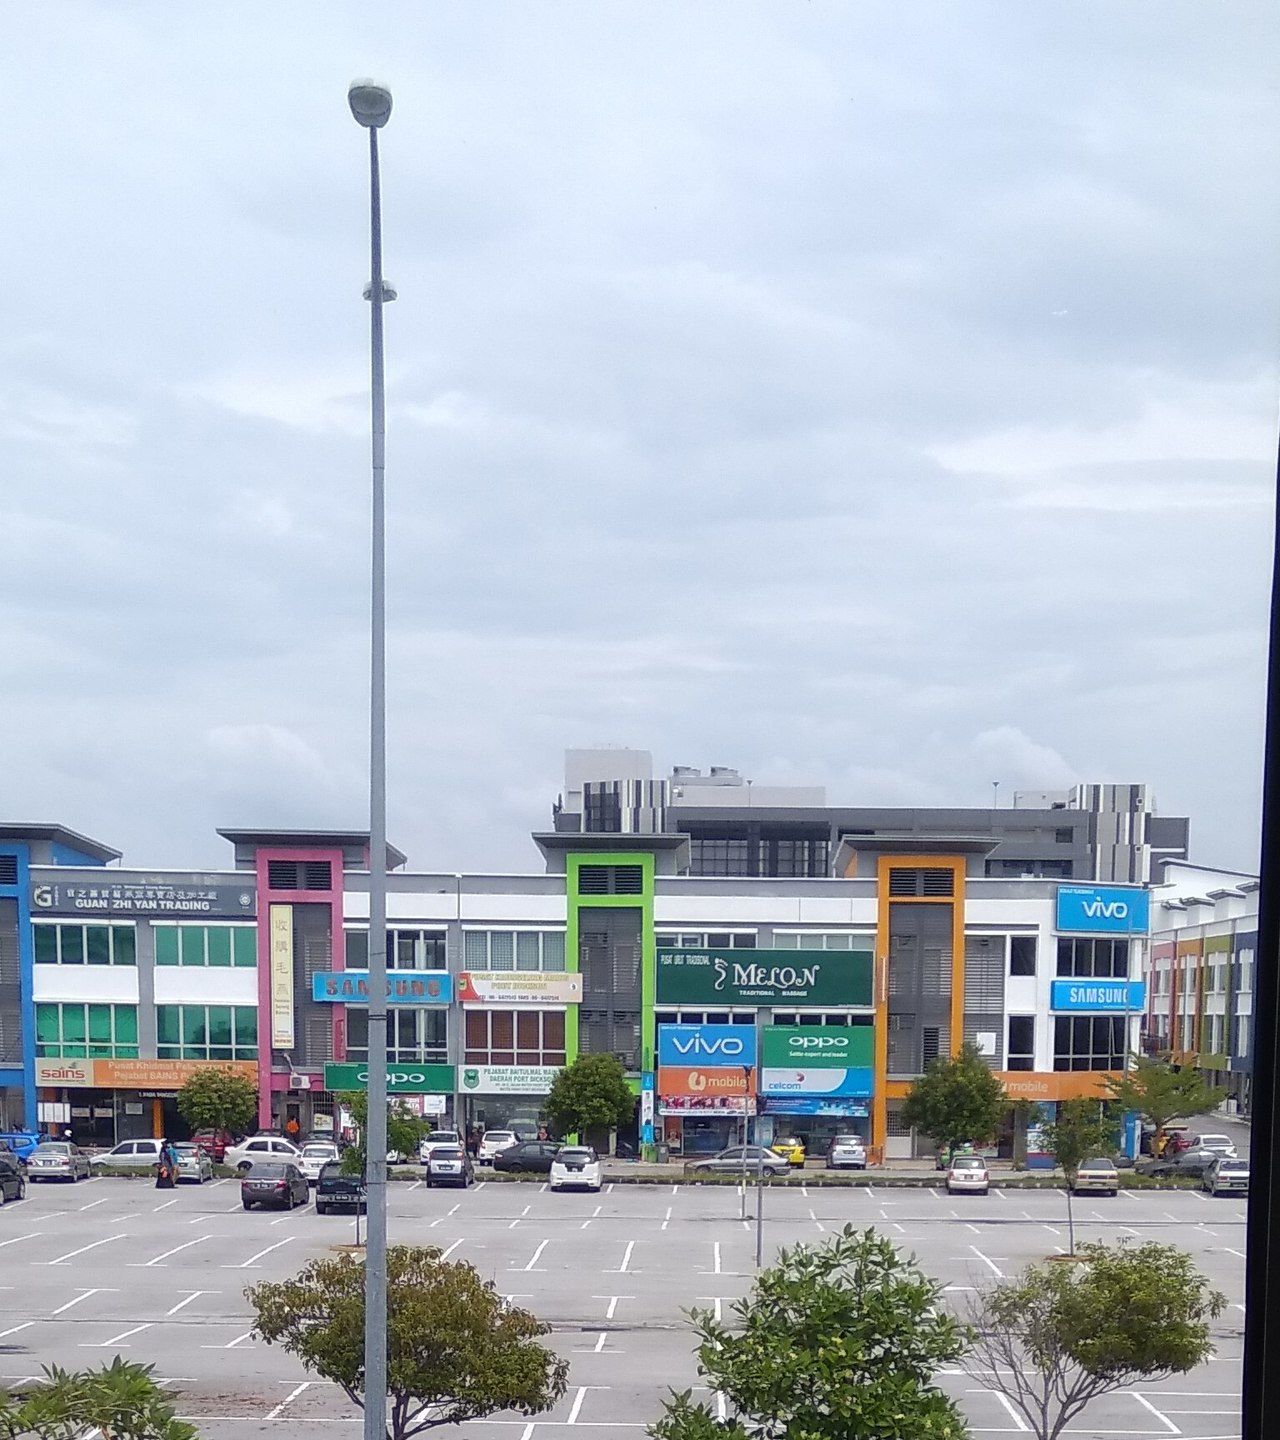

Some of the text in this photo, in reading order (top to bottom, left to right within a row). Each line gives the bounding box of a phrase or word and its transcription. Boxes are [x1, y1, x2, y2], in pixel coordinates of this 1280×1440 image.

[75, 899, 210, 910] GUAN ZHI YAN TRADING
[1082, 896, 1128, 918] vivo
[326, 979, 441, 996] SAMUNG
[673, 1032, 743, 1055] vivo
[789, 1036, 849, 1048] oppo
[41, 1066, 85, 1078] sains
[708, 1076, 747, 1087] mobile
[769, 1082, 801, 1090] celcom
[1009, 1081, 1048, 1093] mobile
